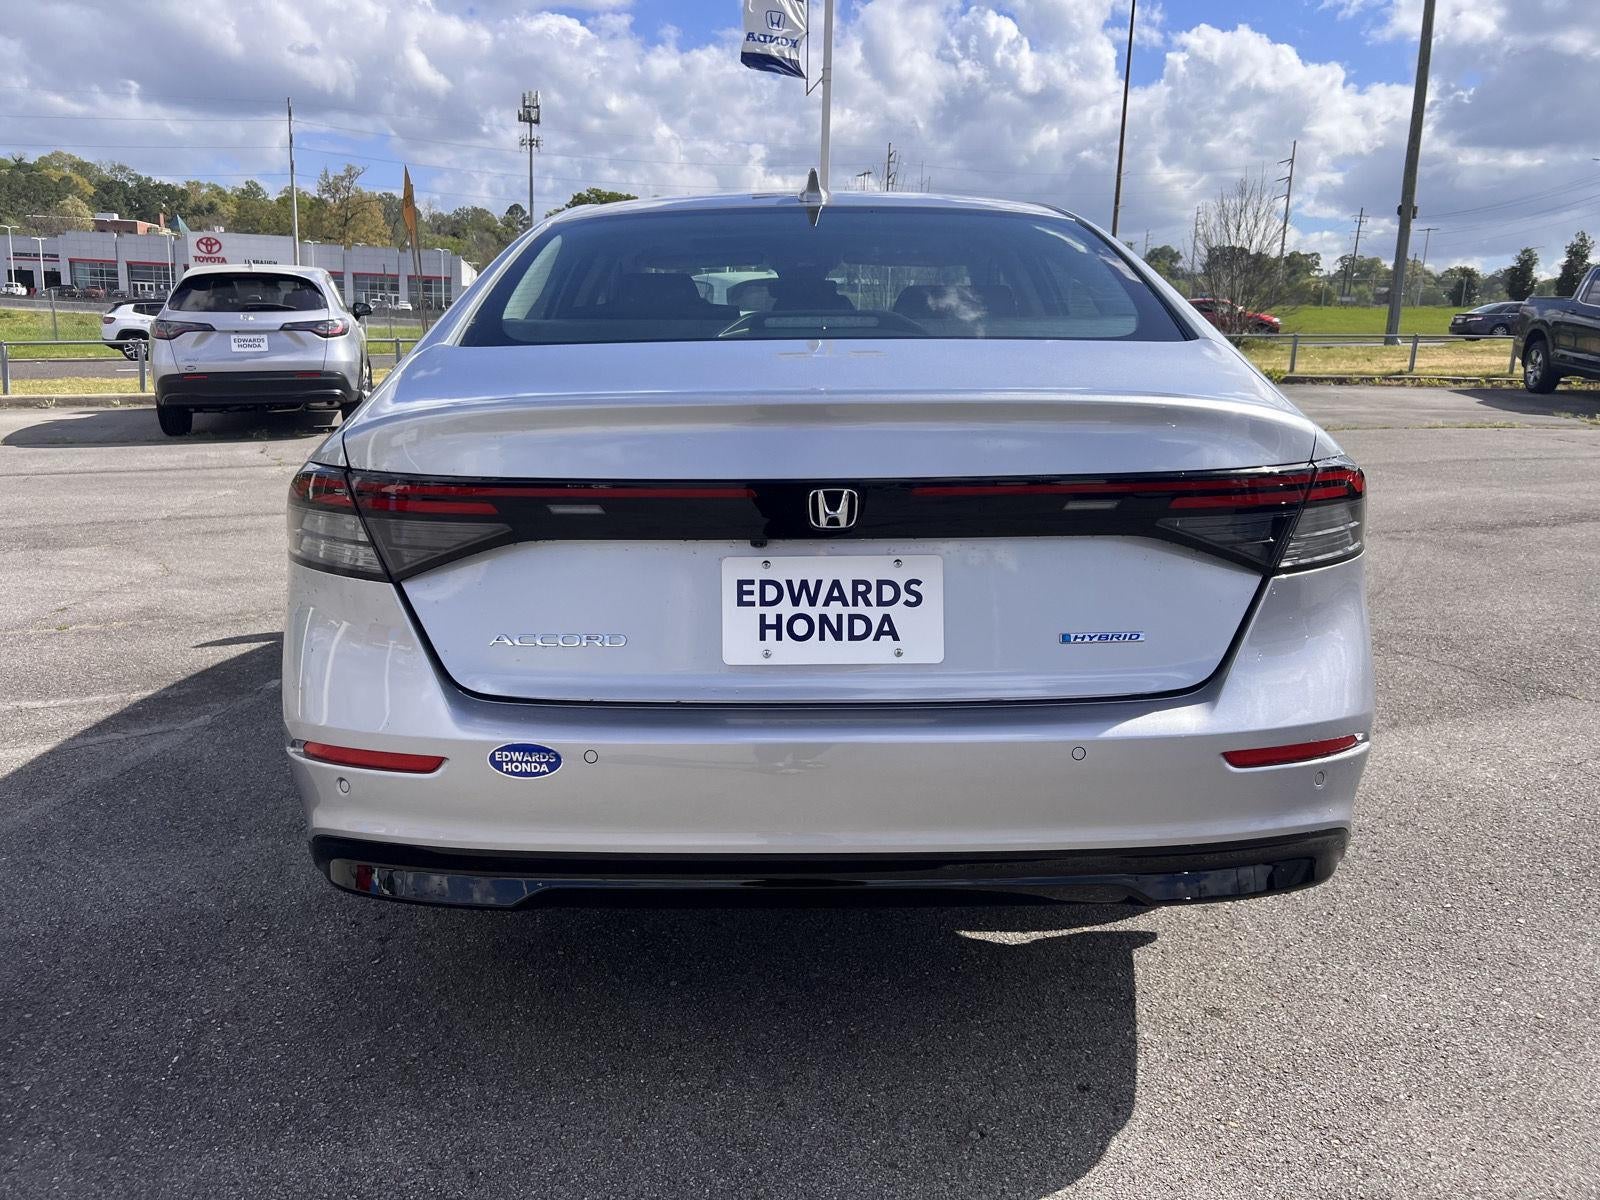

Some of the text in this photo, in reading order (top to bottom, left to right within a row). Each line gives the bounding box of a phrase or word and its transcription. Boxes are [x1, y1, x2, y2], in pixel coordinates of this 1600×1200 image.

[193, 255, 227, 264] TOYOTA
[736, 578, 924, 608] EDWARDS
[759, 612, 901, 642] HONDA
[489, 633, 627, 647] ACCORD
[1073, 633, 1141, 642] HYBRID
[495, 751, 556, 762] EDWARDS
[503, 762, 549, 773] HONDA
